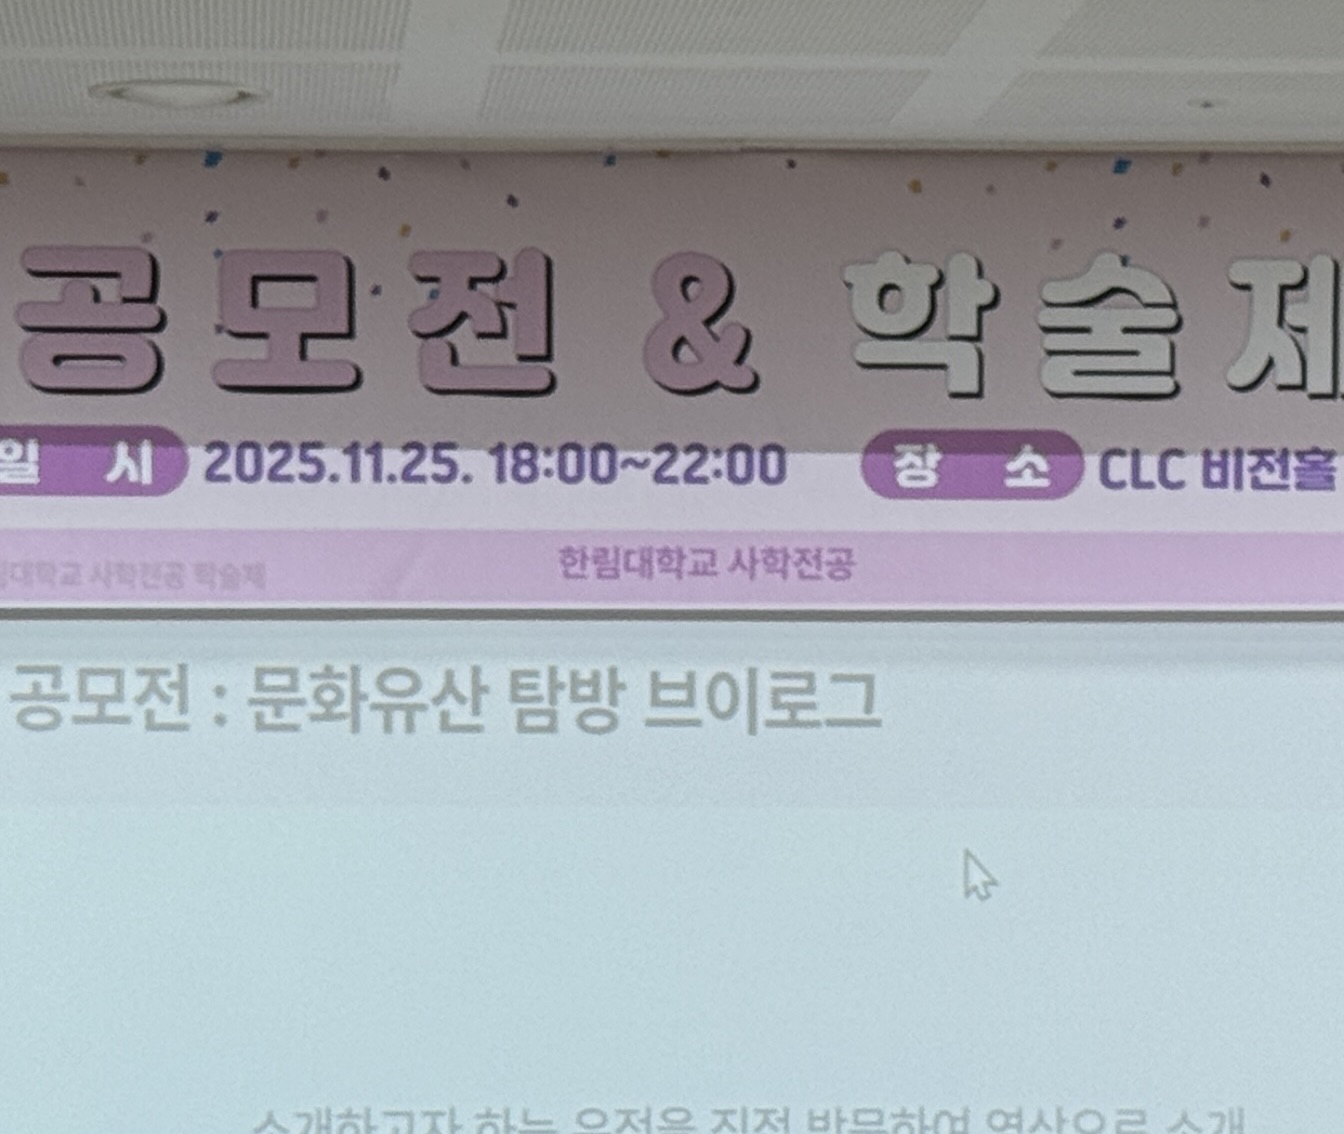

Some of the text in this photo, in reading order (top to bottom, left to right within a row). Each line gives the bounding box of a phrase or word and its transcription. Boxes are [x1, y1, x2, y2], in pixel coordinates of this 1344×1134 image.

[15, 244, 558, 397] 공모전
[643, 249, 761, 397] &
[203, 440, 472, 485] 2025.11.25.
[489, 441, 787, 487] 18:00~22:00
[1098, 447, 1186, 491] CLC
[1202, 445, 1338, 492] 비전홀
[559, 545, 857, 582] 한림대학교 사학전공
[9, 662, 191, 733] 공모전
[213, 683, 228, 728] :
[248, 662, 490, 735] 문화유산
[509, 664, 628, 735] 탐방
[644, 665, 883, 736] 브이로그
